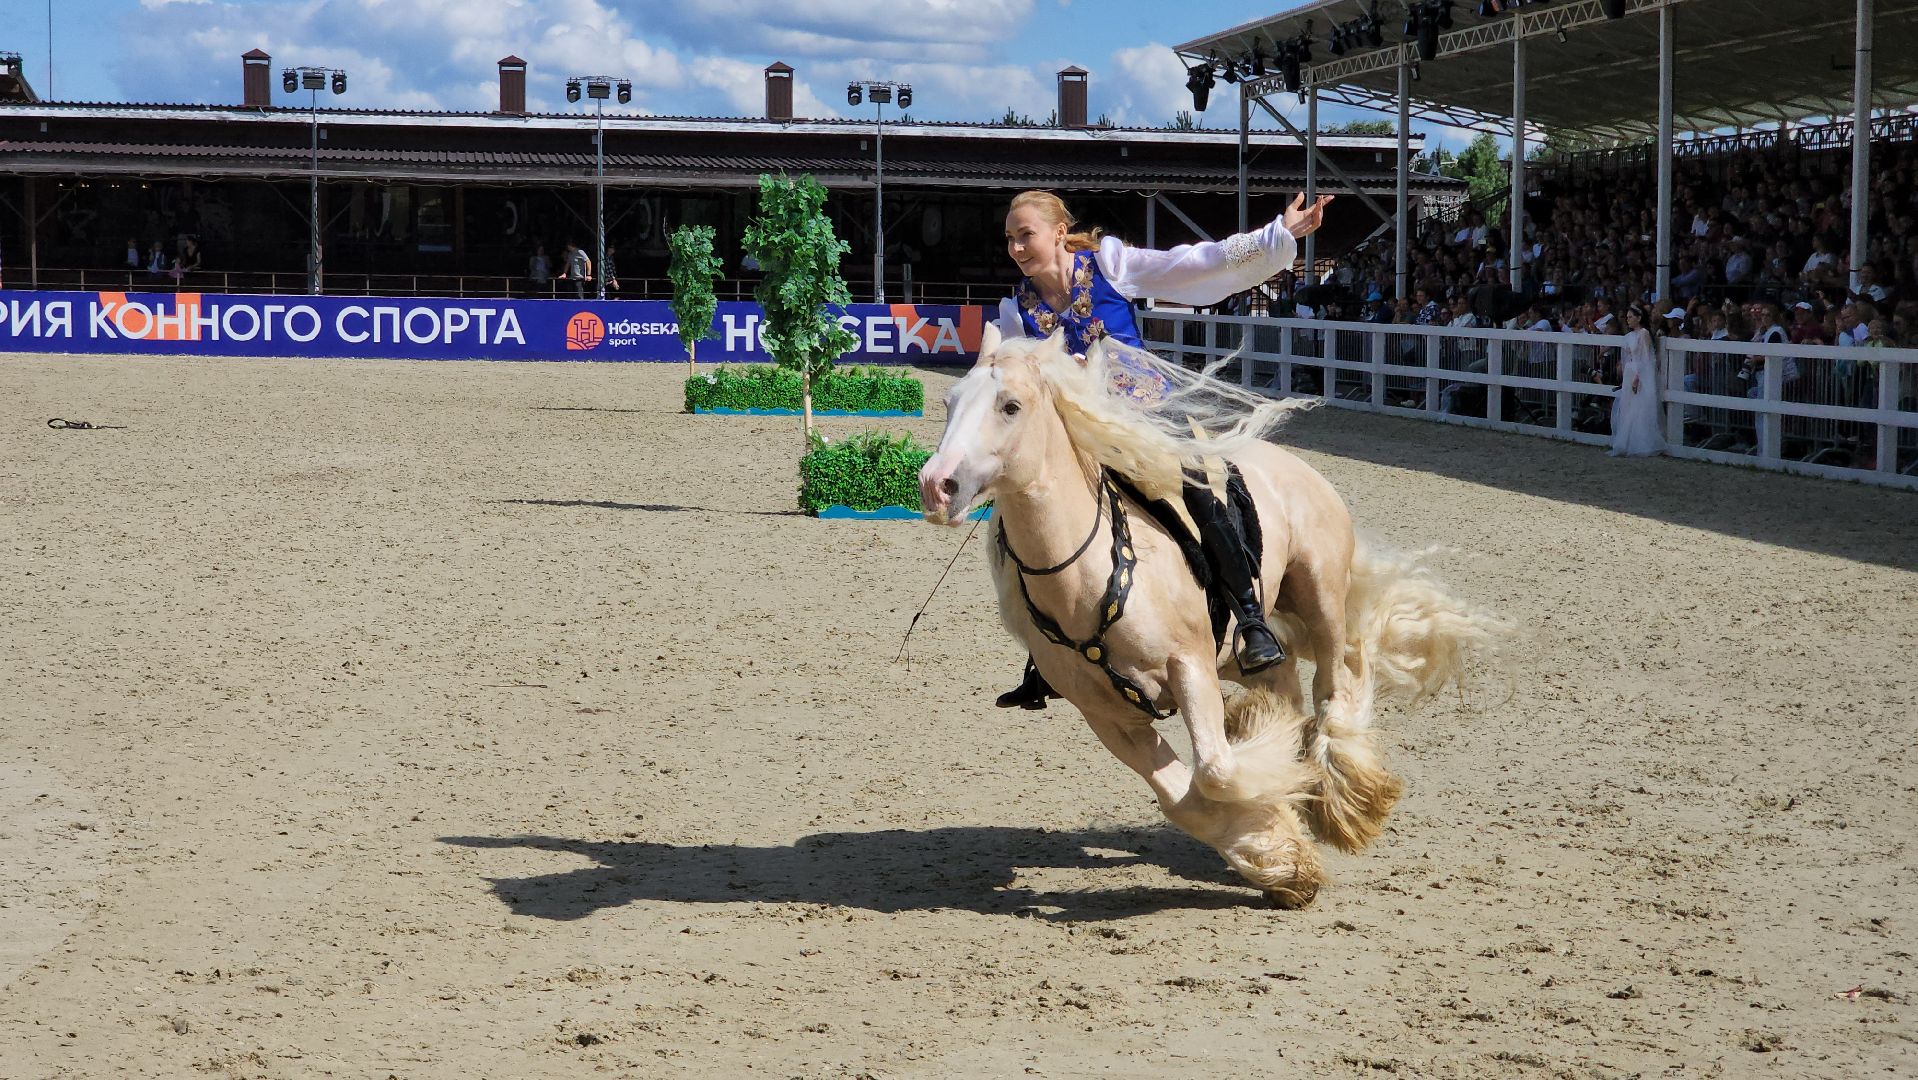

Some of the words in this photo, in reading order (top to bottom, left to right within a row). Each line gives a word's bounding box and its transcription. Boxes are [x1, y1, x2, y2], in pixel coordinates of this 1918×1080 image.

[90, 301, 322, 343] КОННОГО
[335, 305, 526, 345] СПОРТА
[609, 337, 637, 347] sport
[722, 314, 965, 355] HSEKA
